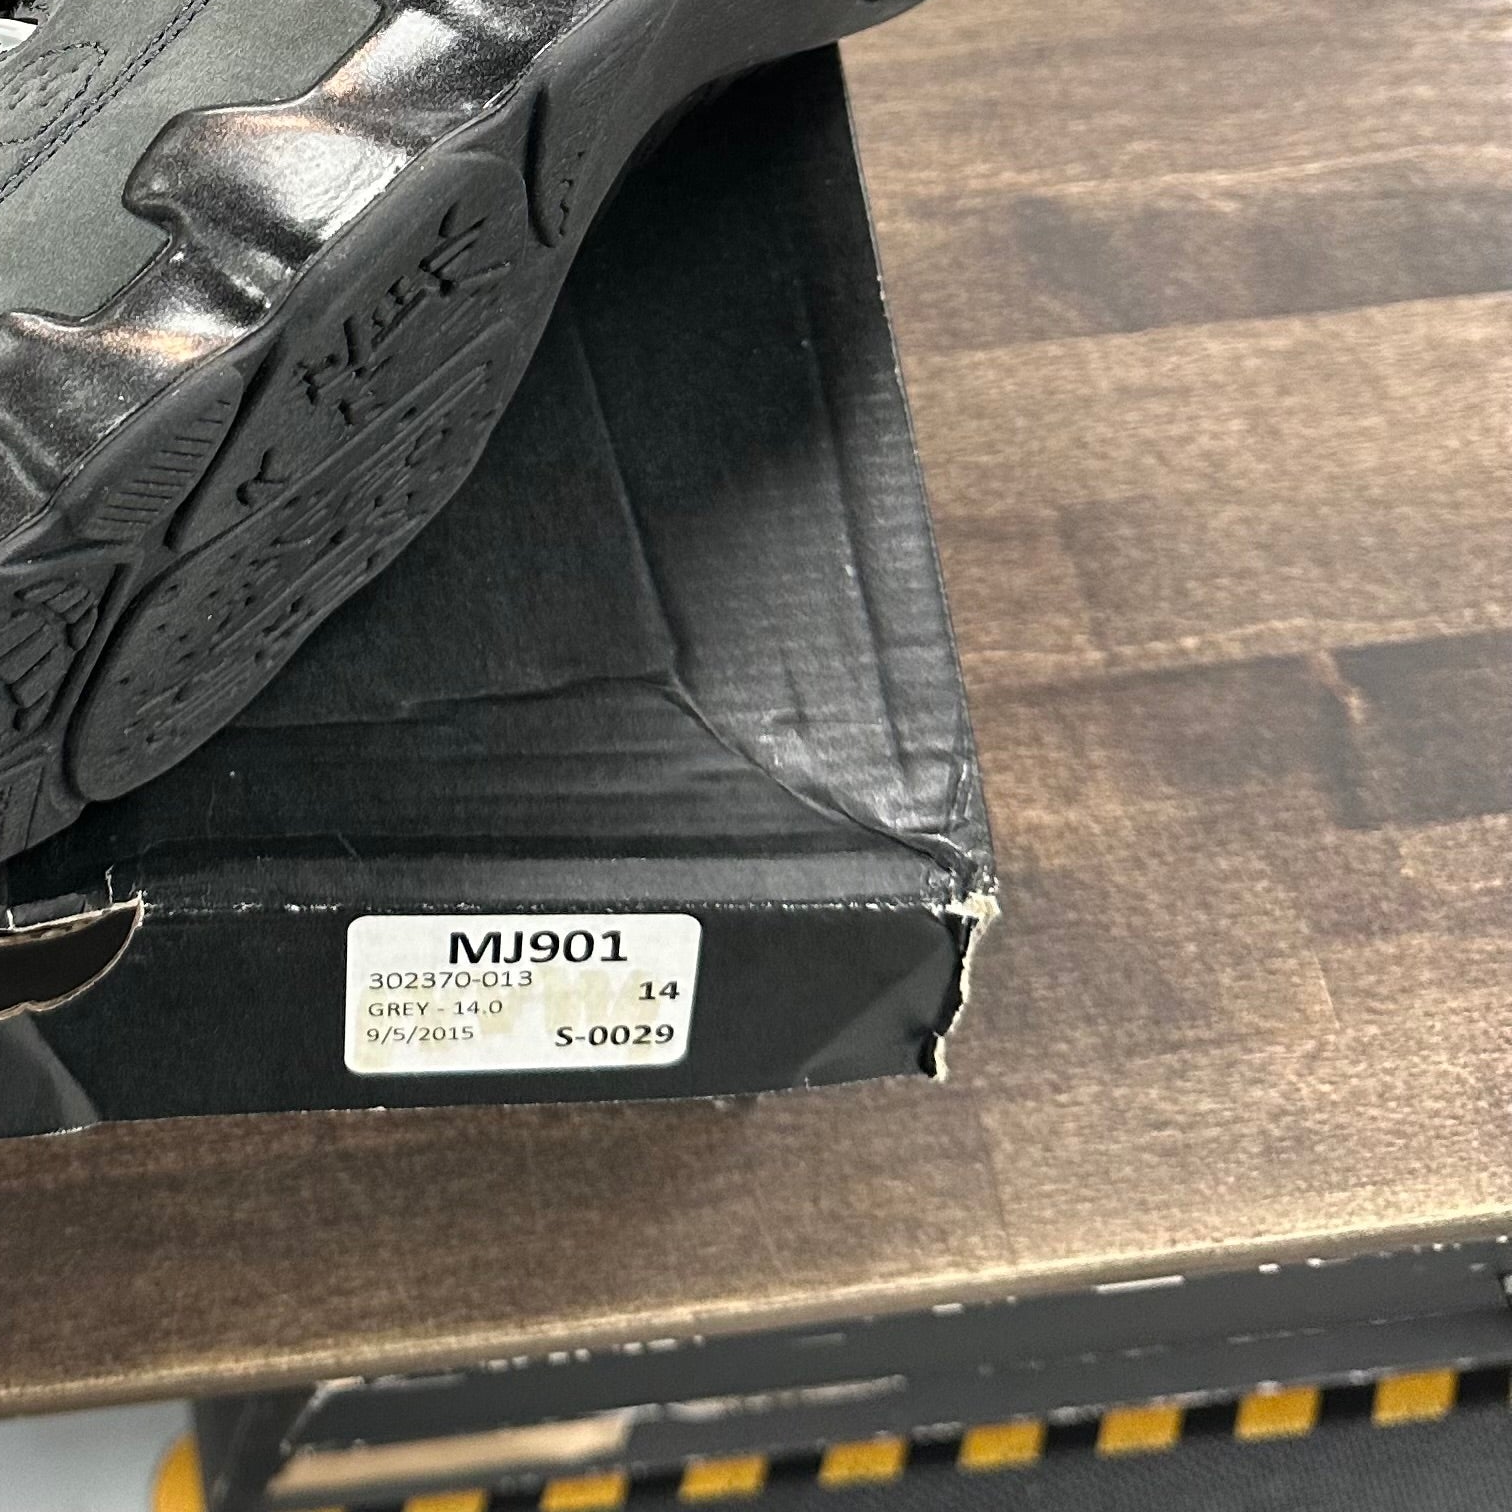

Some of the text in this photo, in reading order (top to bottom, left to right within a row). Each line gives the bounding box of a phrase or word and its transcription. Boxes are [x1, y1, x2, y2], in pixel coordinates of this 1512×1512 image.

[449, 930, 627, 964] MJ901
[369, 971, 533, 990] 302370-013
[638, 981, 679, 1001] 14
[369, 1001, 428, 1017] GREY
[453, 1000, 503, 1015] 14.0
[367, 1026, 474, 1044] 9/5/2015
[555, 1024, 674, 1047] S-0029
